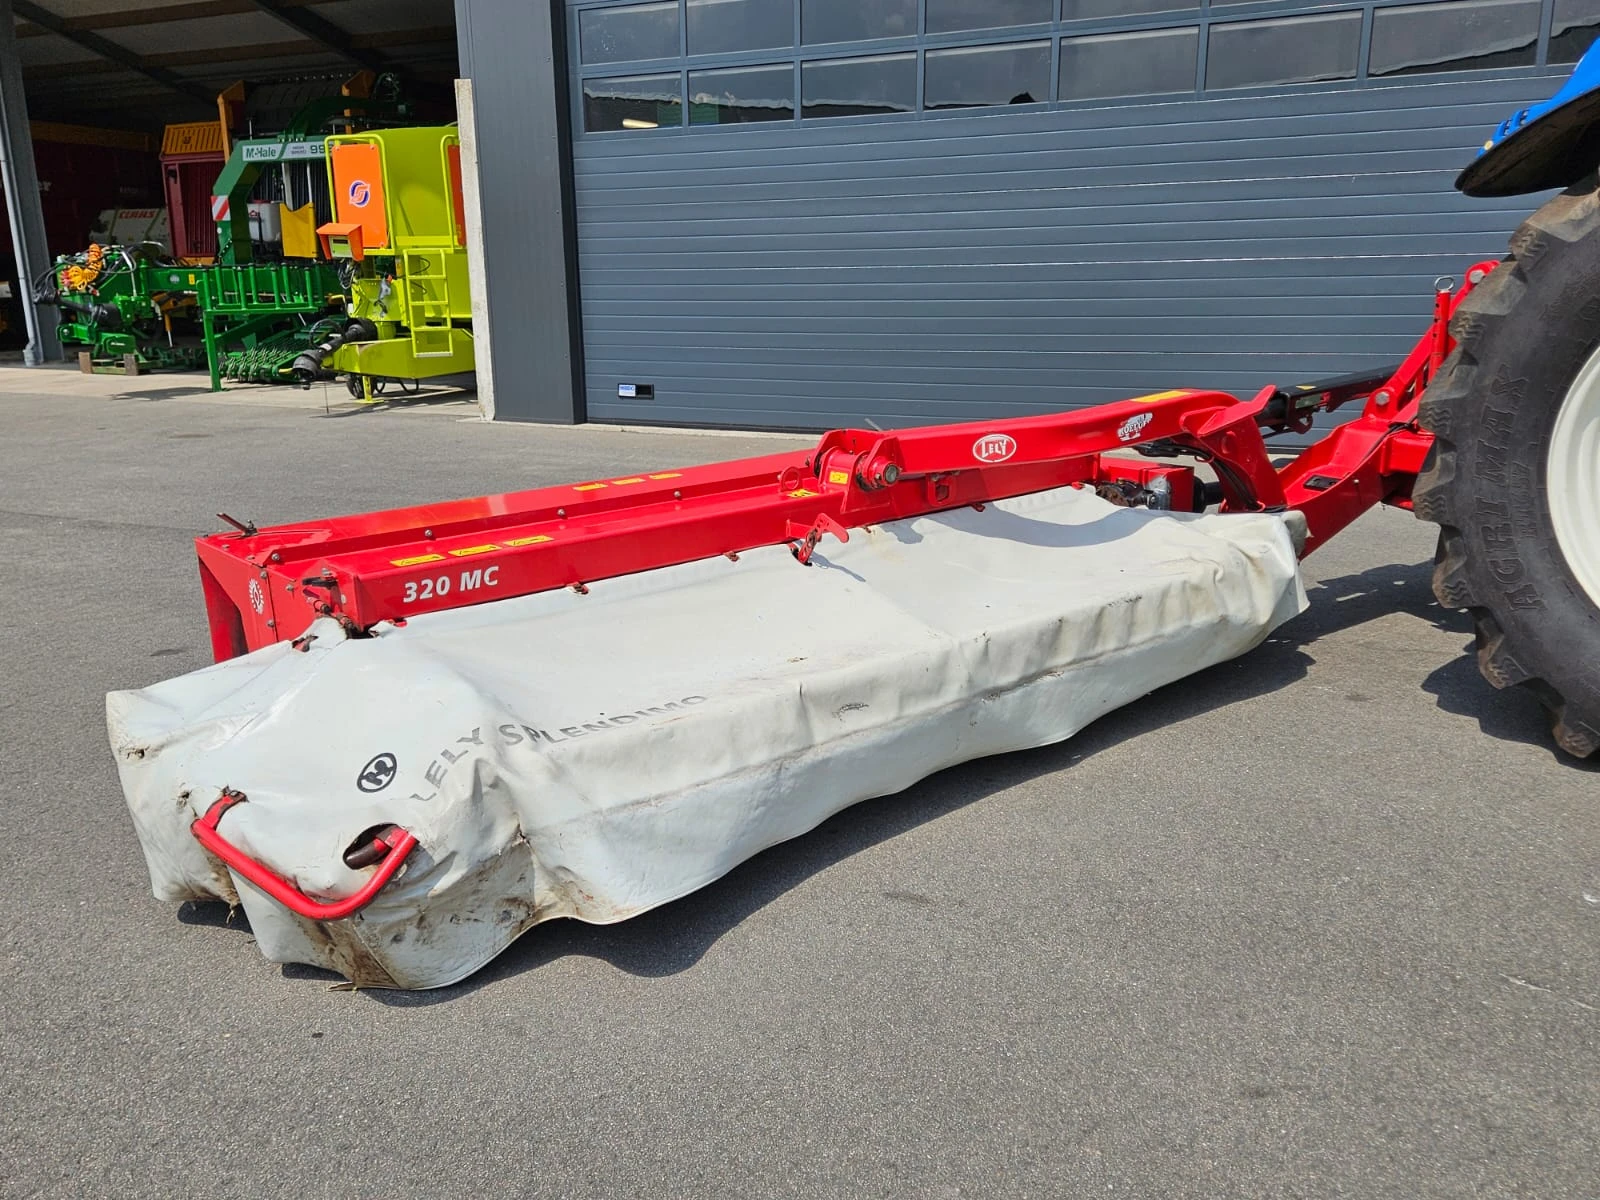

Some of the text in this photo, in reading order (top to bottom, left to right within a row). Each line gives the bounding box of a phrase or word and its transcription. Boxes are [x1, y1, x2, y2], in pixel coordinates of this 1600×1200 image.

[309, 144, 332, 155] 99
[981, 439, 1007, 458] LELY
[403, 566, 499, 603] 320 MC
[409, 694, 707, 801] LELY SPLENDIMO
